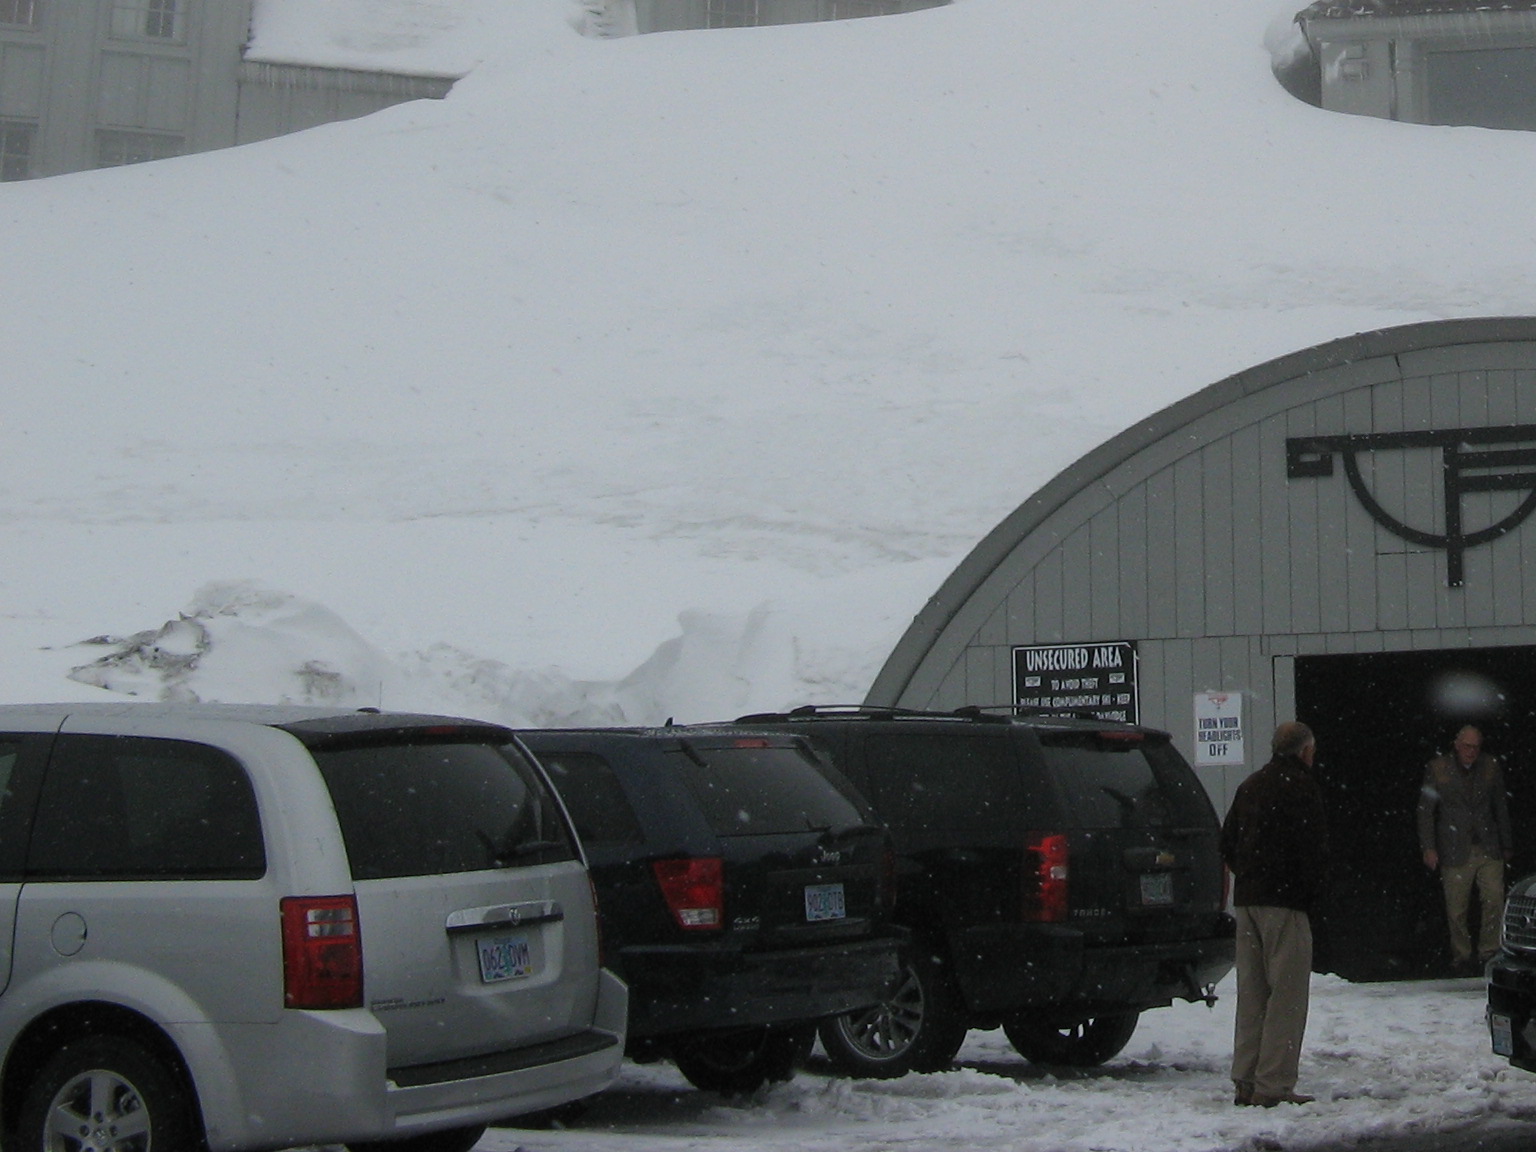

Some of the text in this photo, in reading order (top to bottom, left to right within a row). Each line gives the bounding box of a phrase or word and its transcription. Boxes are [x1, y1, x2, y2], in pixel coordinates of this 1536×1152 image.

[1026, 646, 1123, 671] UNSECURED AREA
[1198, 730, 1242, 742] HEADLIGHTS
[1209, 744, 1228, 756] OFF
